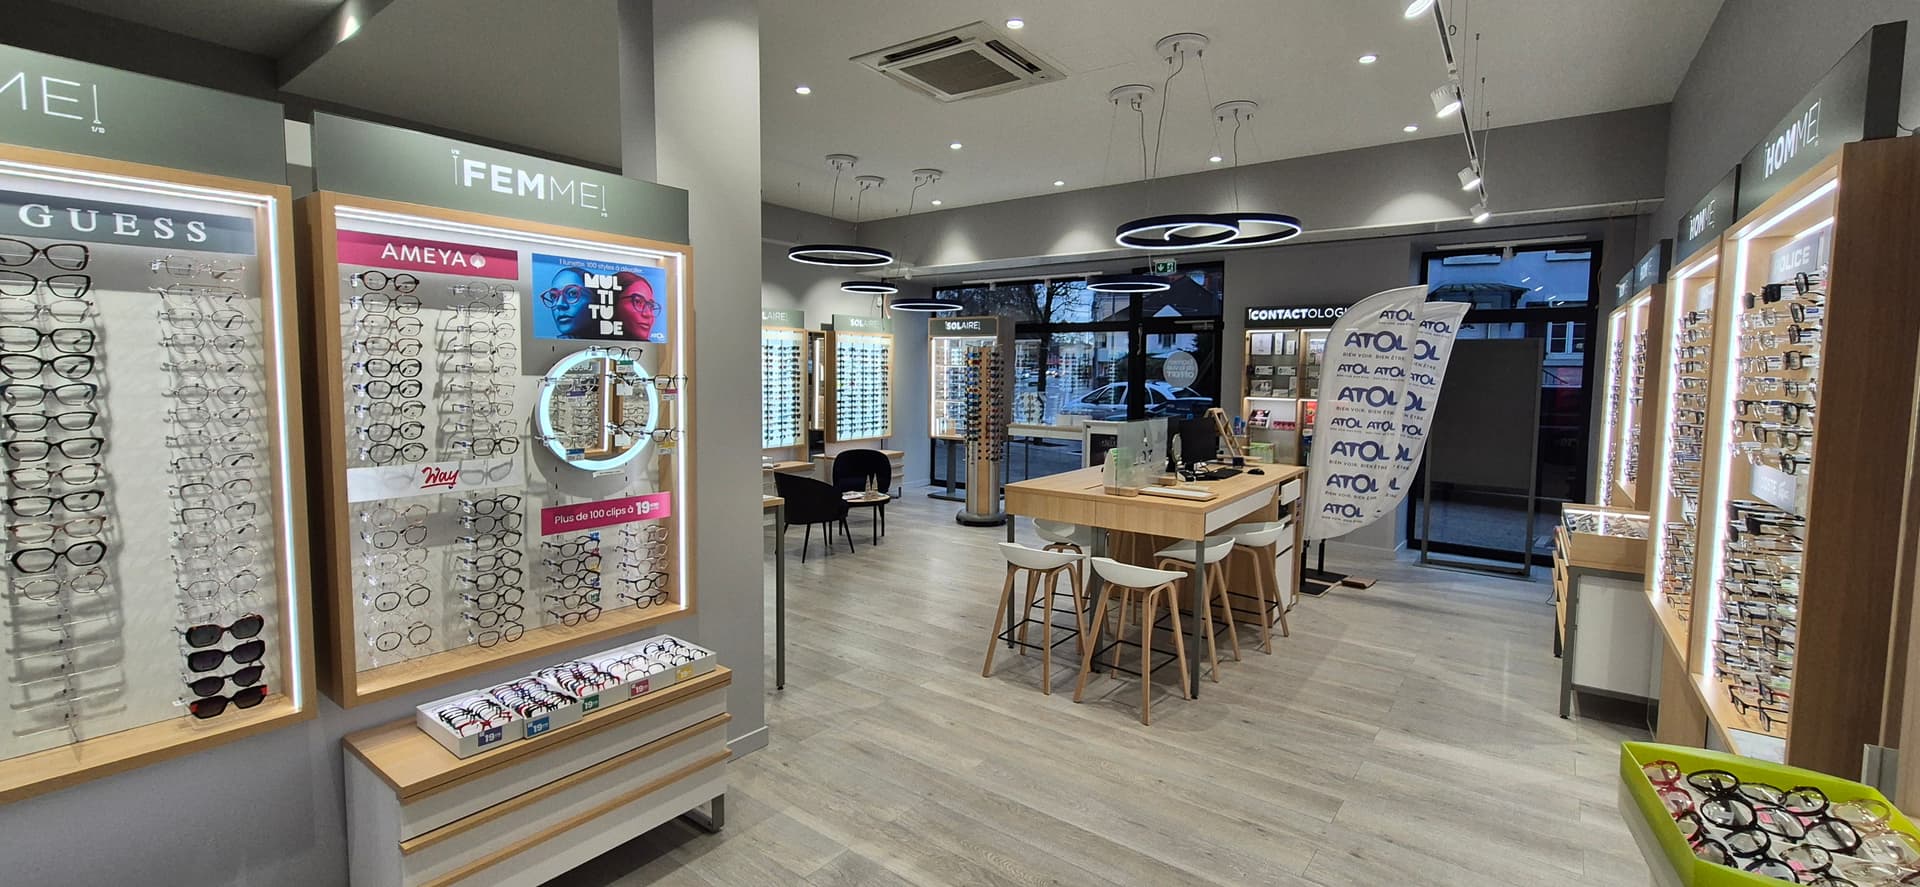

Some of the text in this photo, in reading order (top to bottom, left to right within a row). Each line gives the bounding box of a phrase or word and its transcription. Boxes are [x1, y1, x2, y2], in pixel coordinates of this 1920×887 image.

[463, 158, 599, 209] FEMME
[18, 203, 207, 243] GUESS
[381, 242, 467, 268] AMEYA
[583, 272, 623, 291] MUL
[597, 289, 614, 304] TI
[588, 304, 614, 320] TU
[1379, 309, 1415, 321] ATOL
[599, 320, 623, 336] DE
[945, 321, 979, 330] SOLAIRE
[1344, 331, 1408, 352] ATOL
[1337, 363, 1370, 374] ATOL
[1374, 366, 1406, 378] ATOL
[1337, 386, 1398, 407] ATOL
[1331, 417, 1362, 428] ATOL
[1367, 421, 1395, 432] ATOL
[1330, 440, 1390, 462] ATOL
[421, 466, 459, 485] Way
[1326, 473, 1379, 493] ATOL
[554, 515, 574, 524] Plus
[575, 512, 588, 521] de
[590, 509, 605, 519] 100
[606, 506, 626, 518] clips
[627, 505, 634, 514] à
[1323, 503, 1364, 518] ATOL
[584, 701, 592, 709] 19
[533, 723, 543, 733] 19
[484, 733, 495, 743] 19
